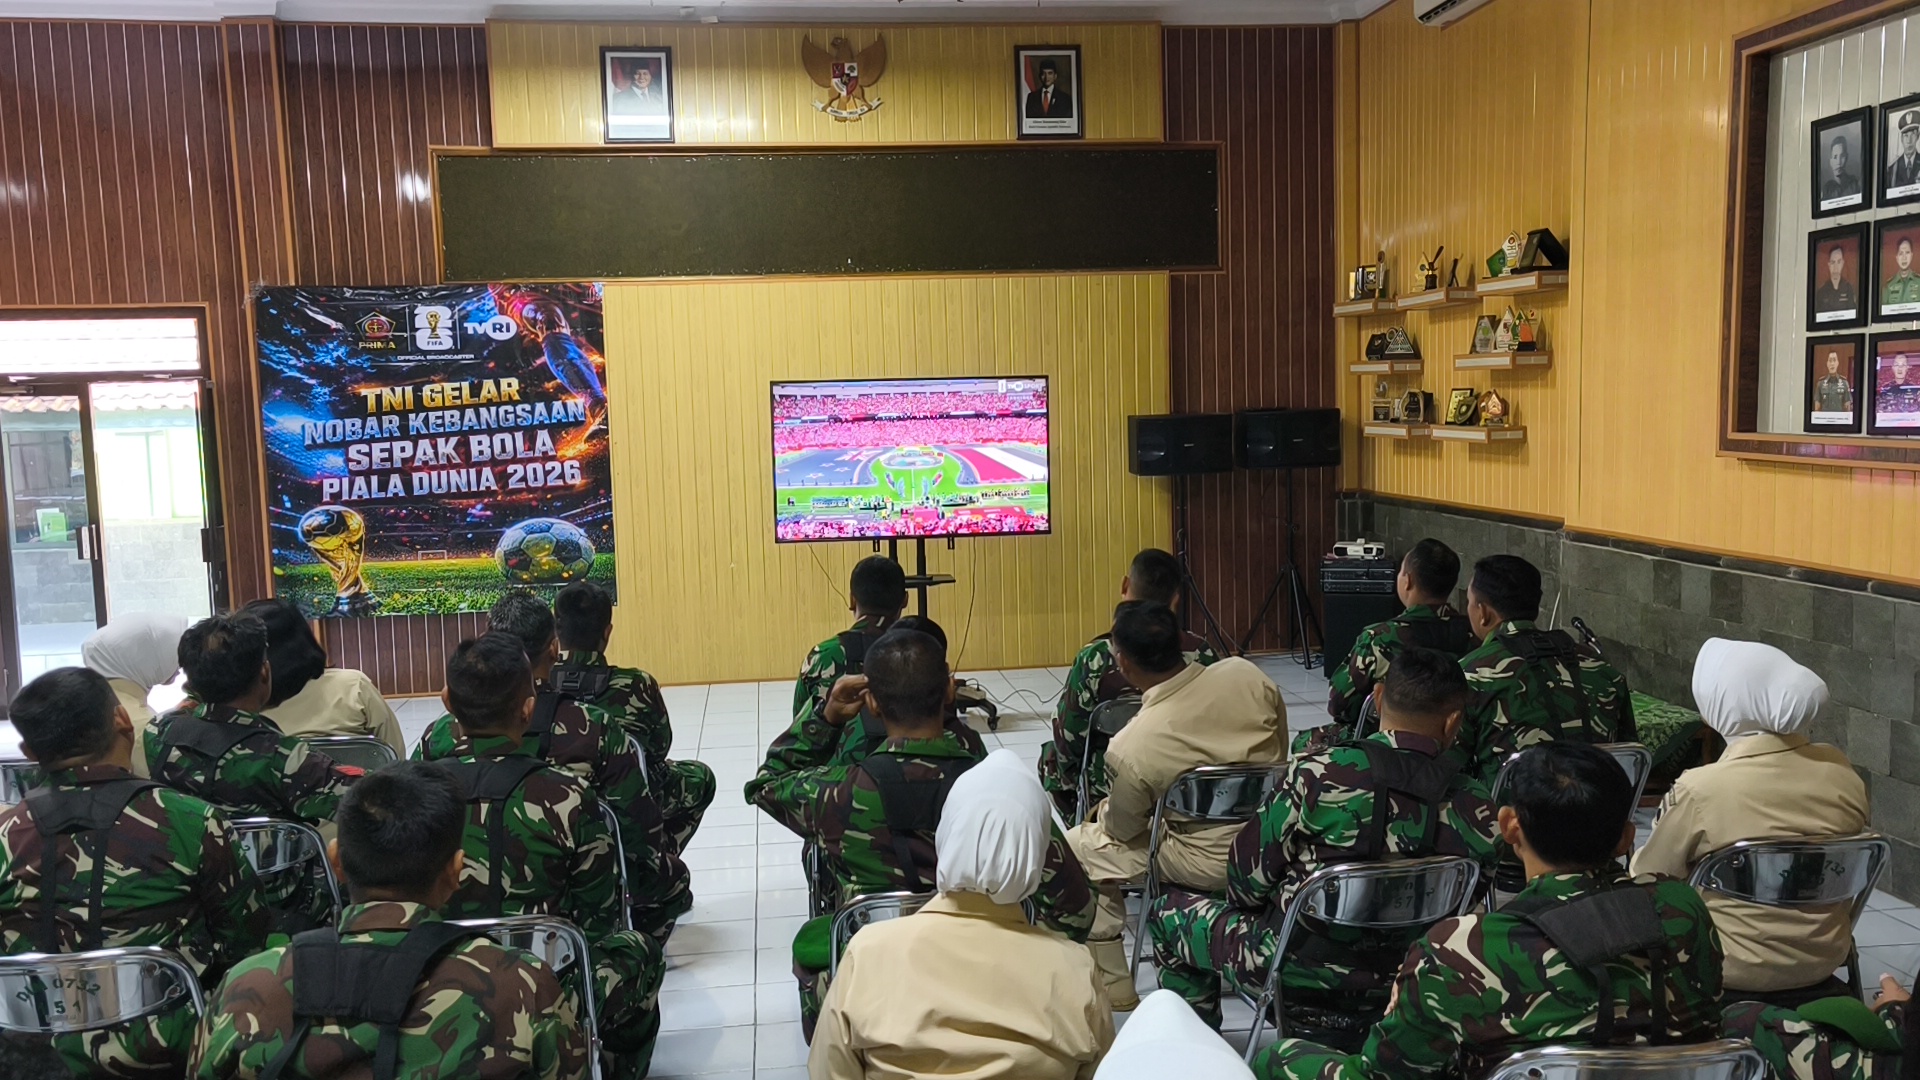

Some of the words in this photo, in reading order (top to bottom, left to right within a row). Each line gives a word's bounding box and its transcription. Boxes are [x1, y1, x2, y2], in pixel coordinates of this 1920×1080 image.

[358, 341, 396, 349] PRIMA
[463, 319, 513, 337] TVRI
[361, 386, 414, 413] TNI
[422, 377, 520, 409] GELAR
[303, 414, 401, 446] NOBAR
[409, 400, 586, 436] KEBANGSAAN
[348, 436, 462, 472] SEPAK
[469, 429, 557, 463] BOLA
[322, 472, 406, 502] PIALA
[412, 467, 498, 496] DUNIA
[507, 460, 581, 488] 2026
